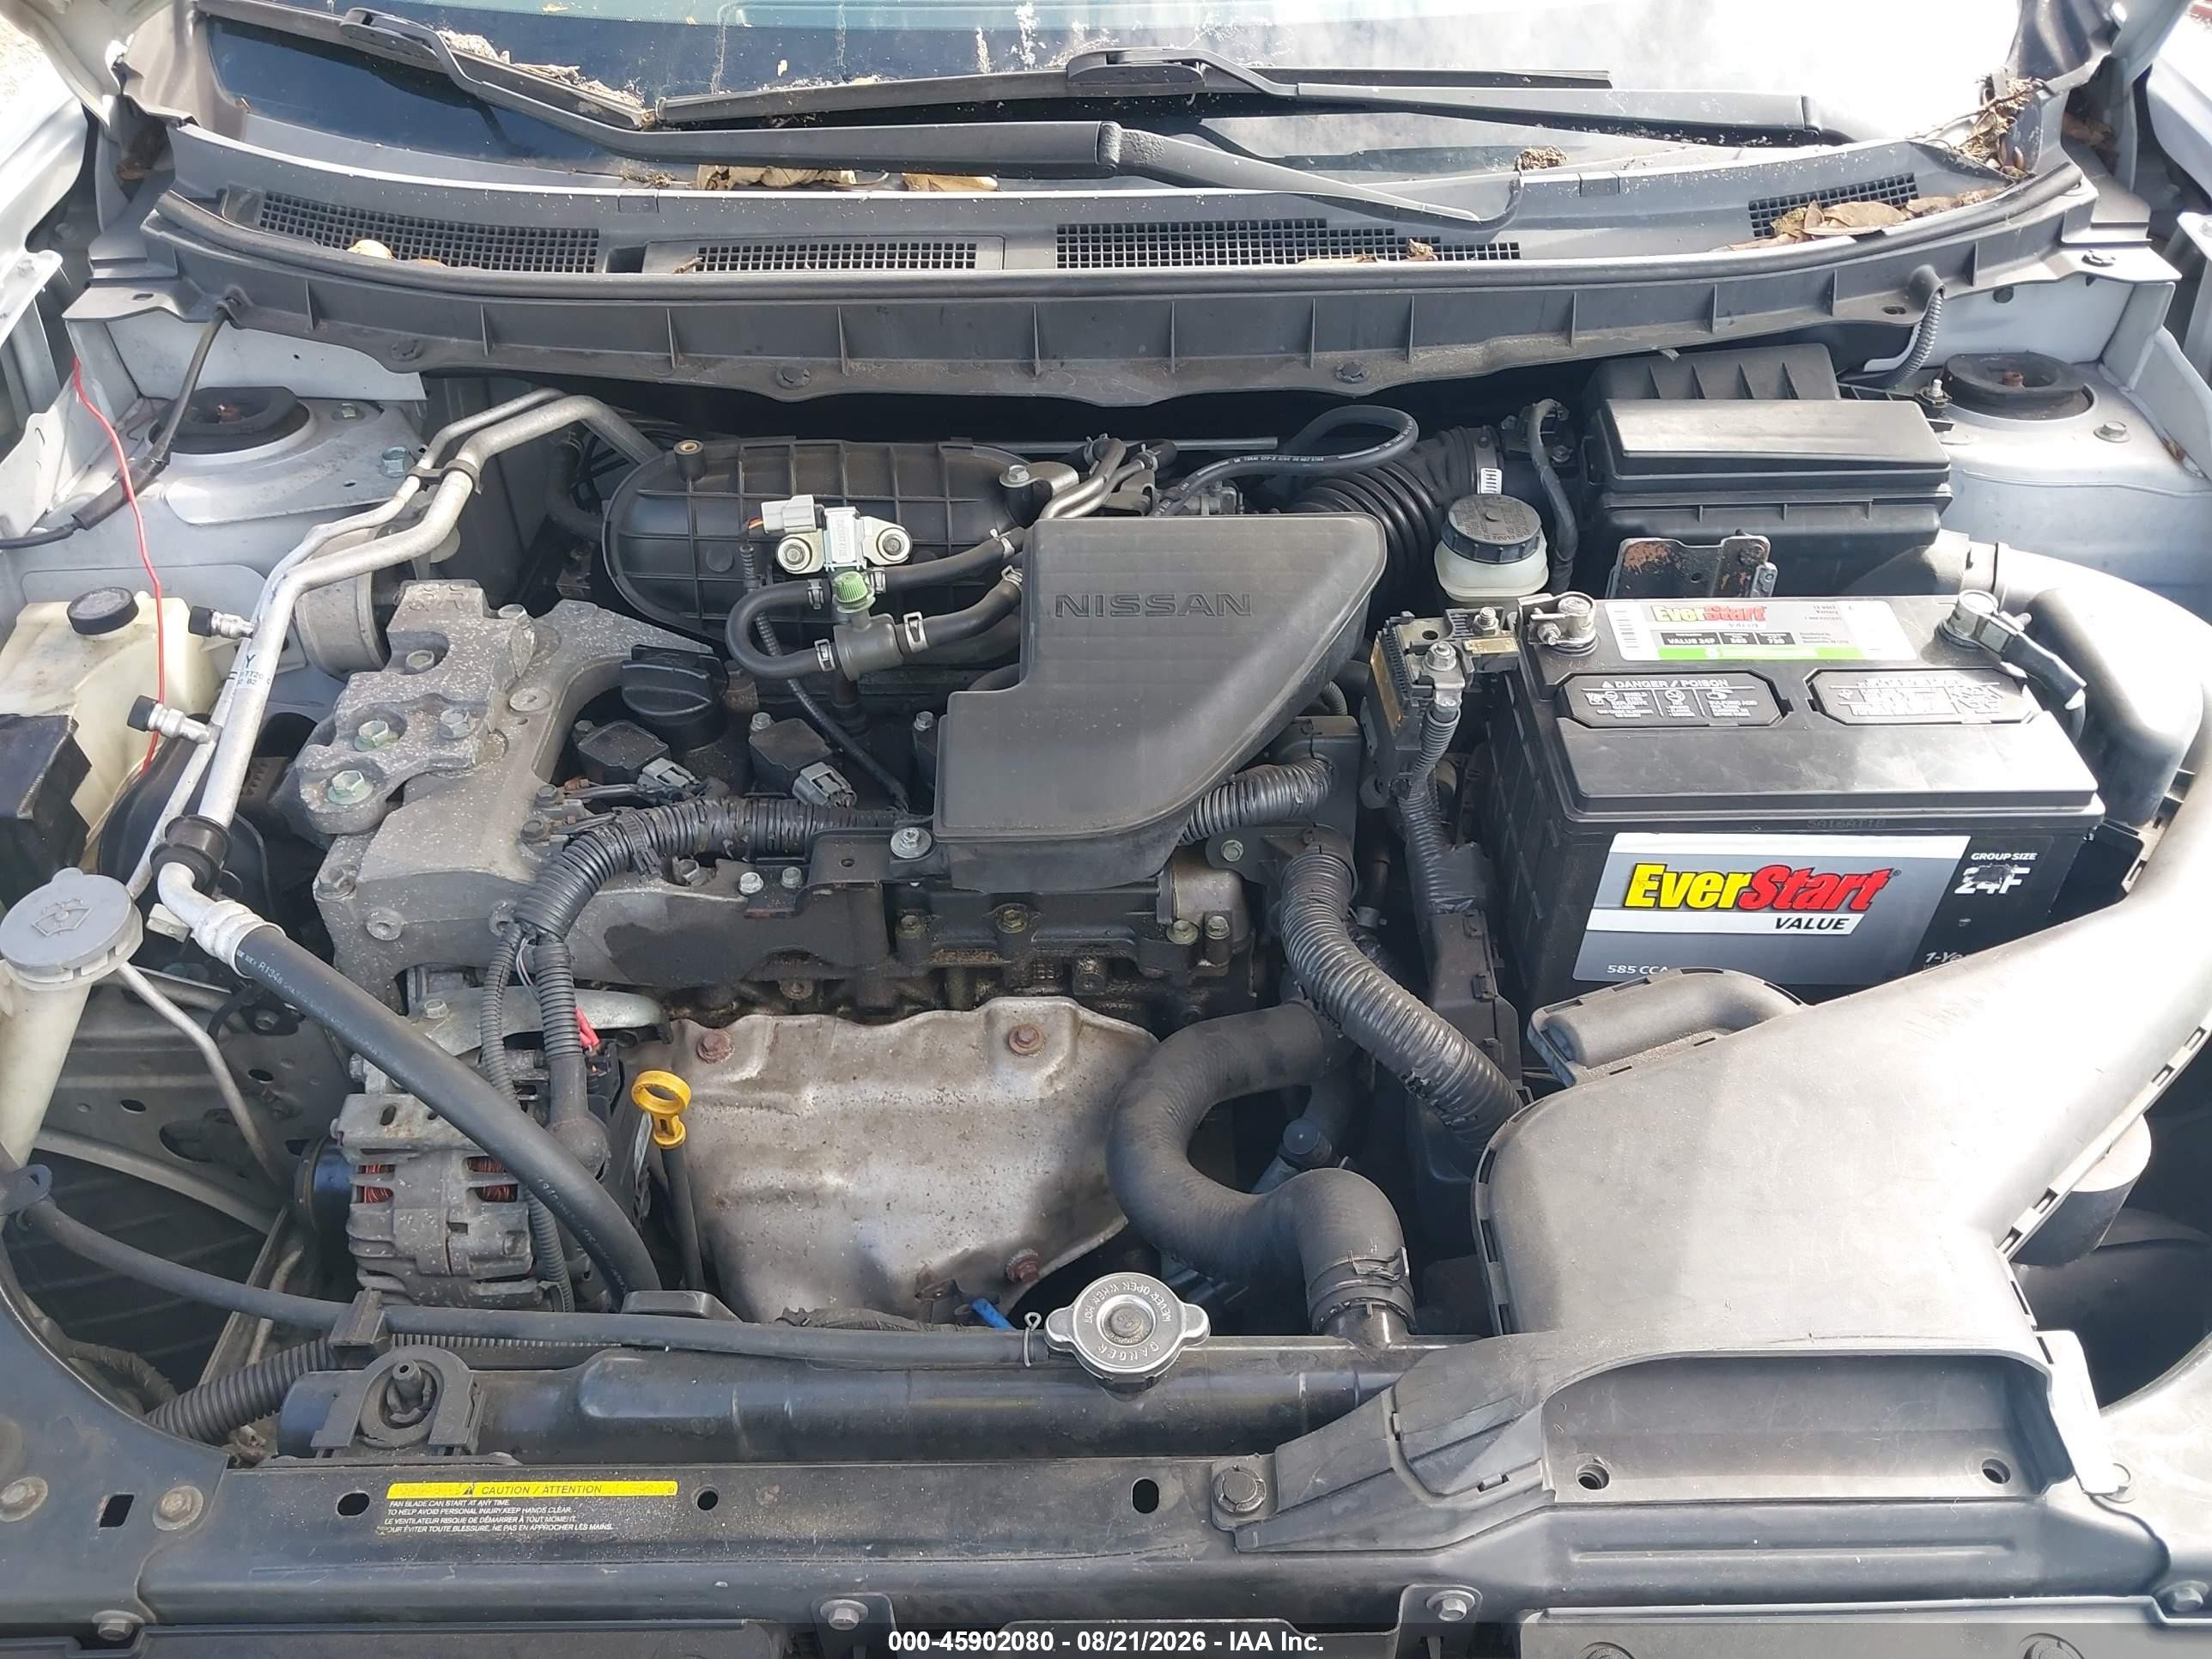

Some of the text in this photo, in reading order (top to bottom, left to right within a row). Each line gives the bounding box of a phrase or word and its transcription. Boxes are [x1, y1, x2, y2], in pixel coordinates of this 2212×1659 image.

[1054, 592, 1253, 618] NISSAN
[1651, 605, 1766, 623] EverStart
[1615, 680, 1668, 689] DANGER
[1681, 679, 1729, 688] POISON
[1621, 862, 1894, 912] EverStart
[1774, 917, 1850, 931] VALUE
[1607, 964, 1637, 975] 585
[1091, 1283, 1120, 1306] WHEN
[1121, 1280, 1152, 1296] OPEN
[1083, 1304, 1097, 1325] HOT
[1149, 1290, 1172, 1323] NEVER
[1097, 1340, 1161, 1362] DANGER
[482, 1486, 531, 1495] CAUTION
[542, 1485, 603, 1495] ATTENTION
[479, 1515, 518, 1523] DÉMARRER
[529, 1523, 574, 1532] APPROCHER
